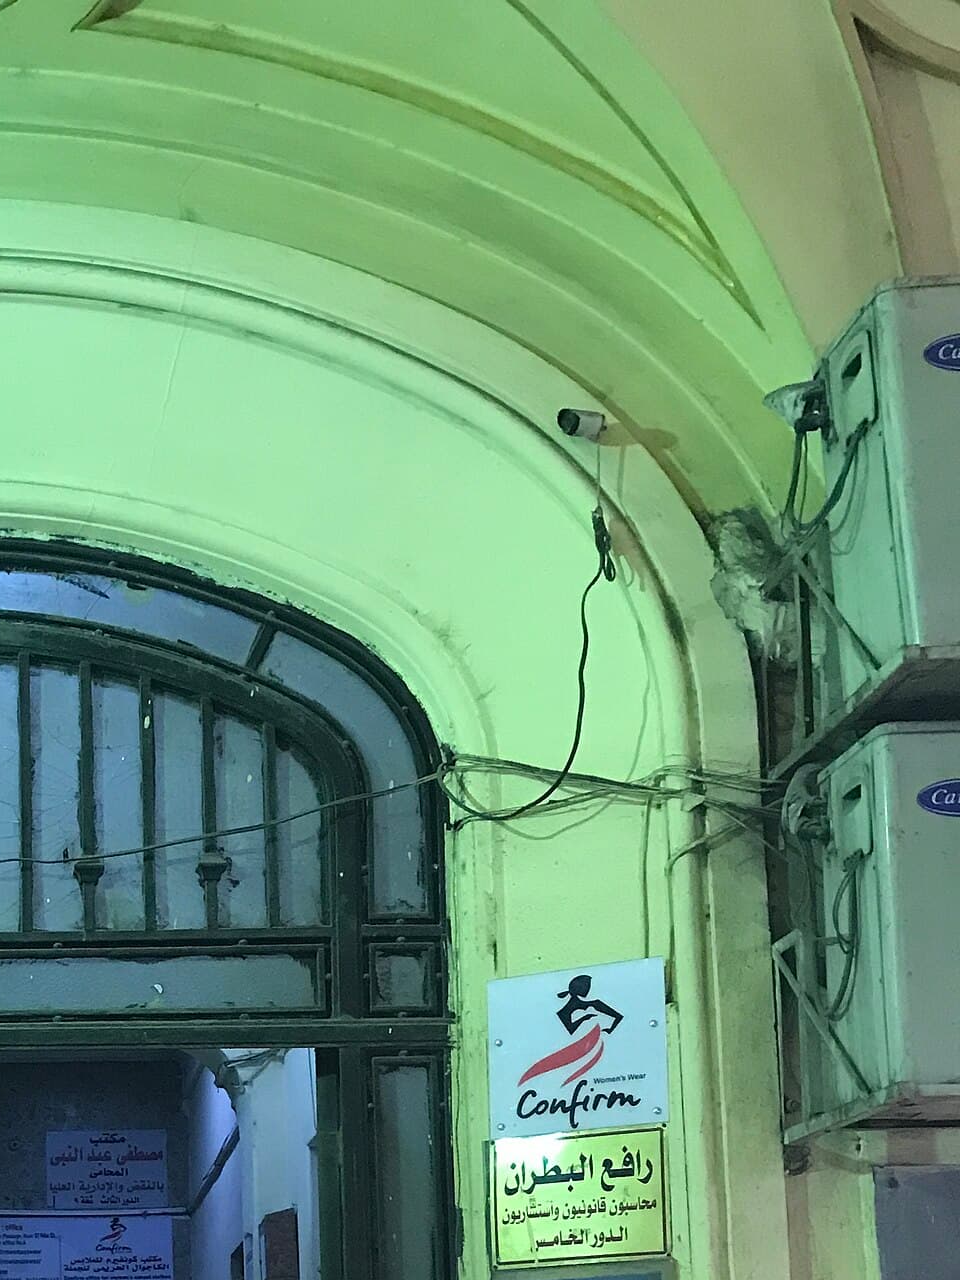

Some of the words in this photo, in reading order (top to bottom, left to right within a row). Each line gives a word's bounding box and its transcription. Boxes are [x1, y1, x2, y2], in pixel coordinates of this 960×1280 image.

[593, 1074, 626, 1085] Women's
[627, 1072, 647, 1081] Wear
[516, 1079, 642, 1129] Confirm
[89, 1132, 127, 1147] مكتب
[87, 1147, 113, 1166] عبد
[116, 1144, 164, 1166] مصطفى
[504, 1152, 594, 1196] البطران
[601, 1145, 654, 1191] رافع
[502, 1199, 560, 1225] واستشاريون
[562, 1196, 607, 1220] قانونيون
[609, 1196, 657, 1217] محاسبون
[590, 1225, 628, 1248] الدور
[141, 1255, 162, 1264] مكتب
